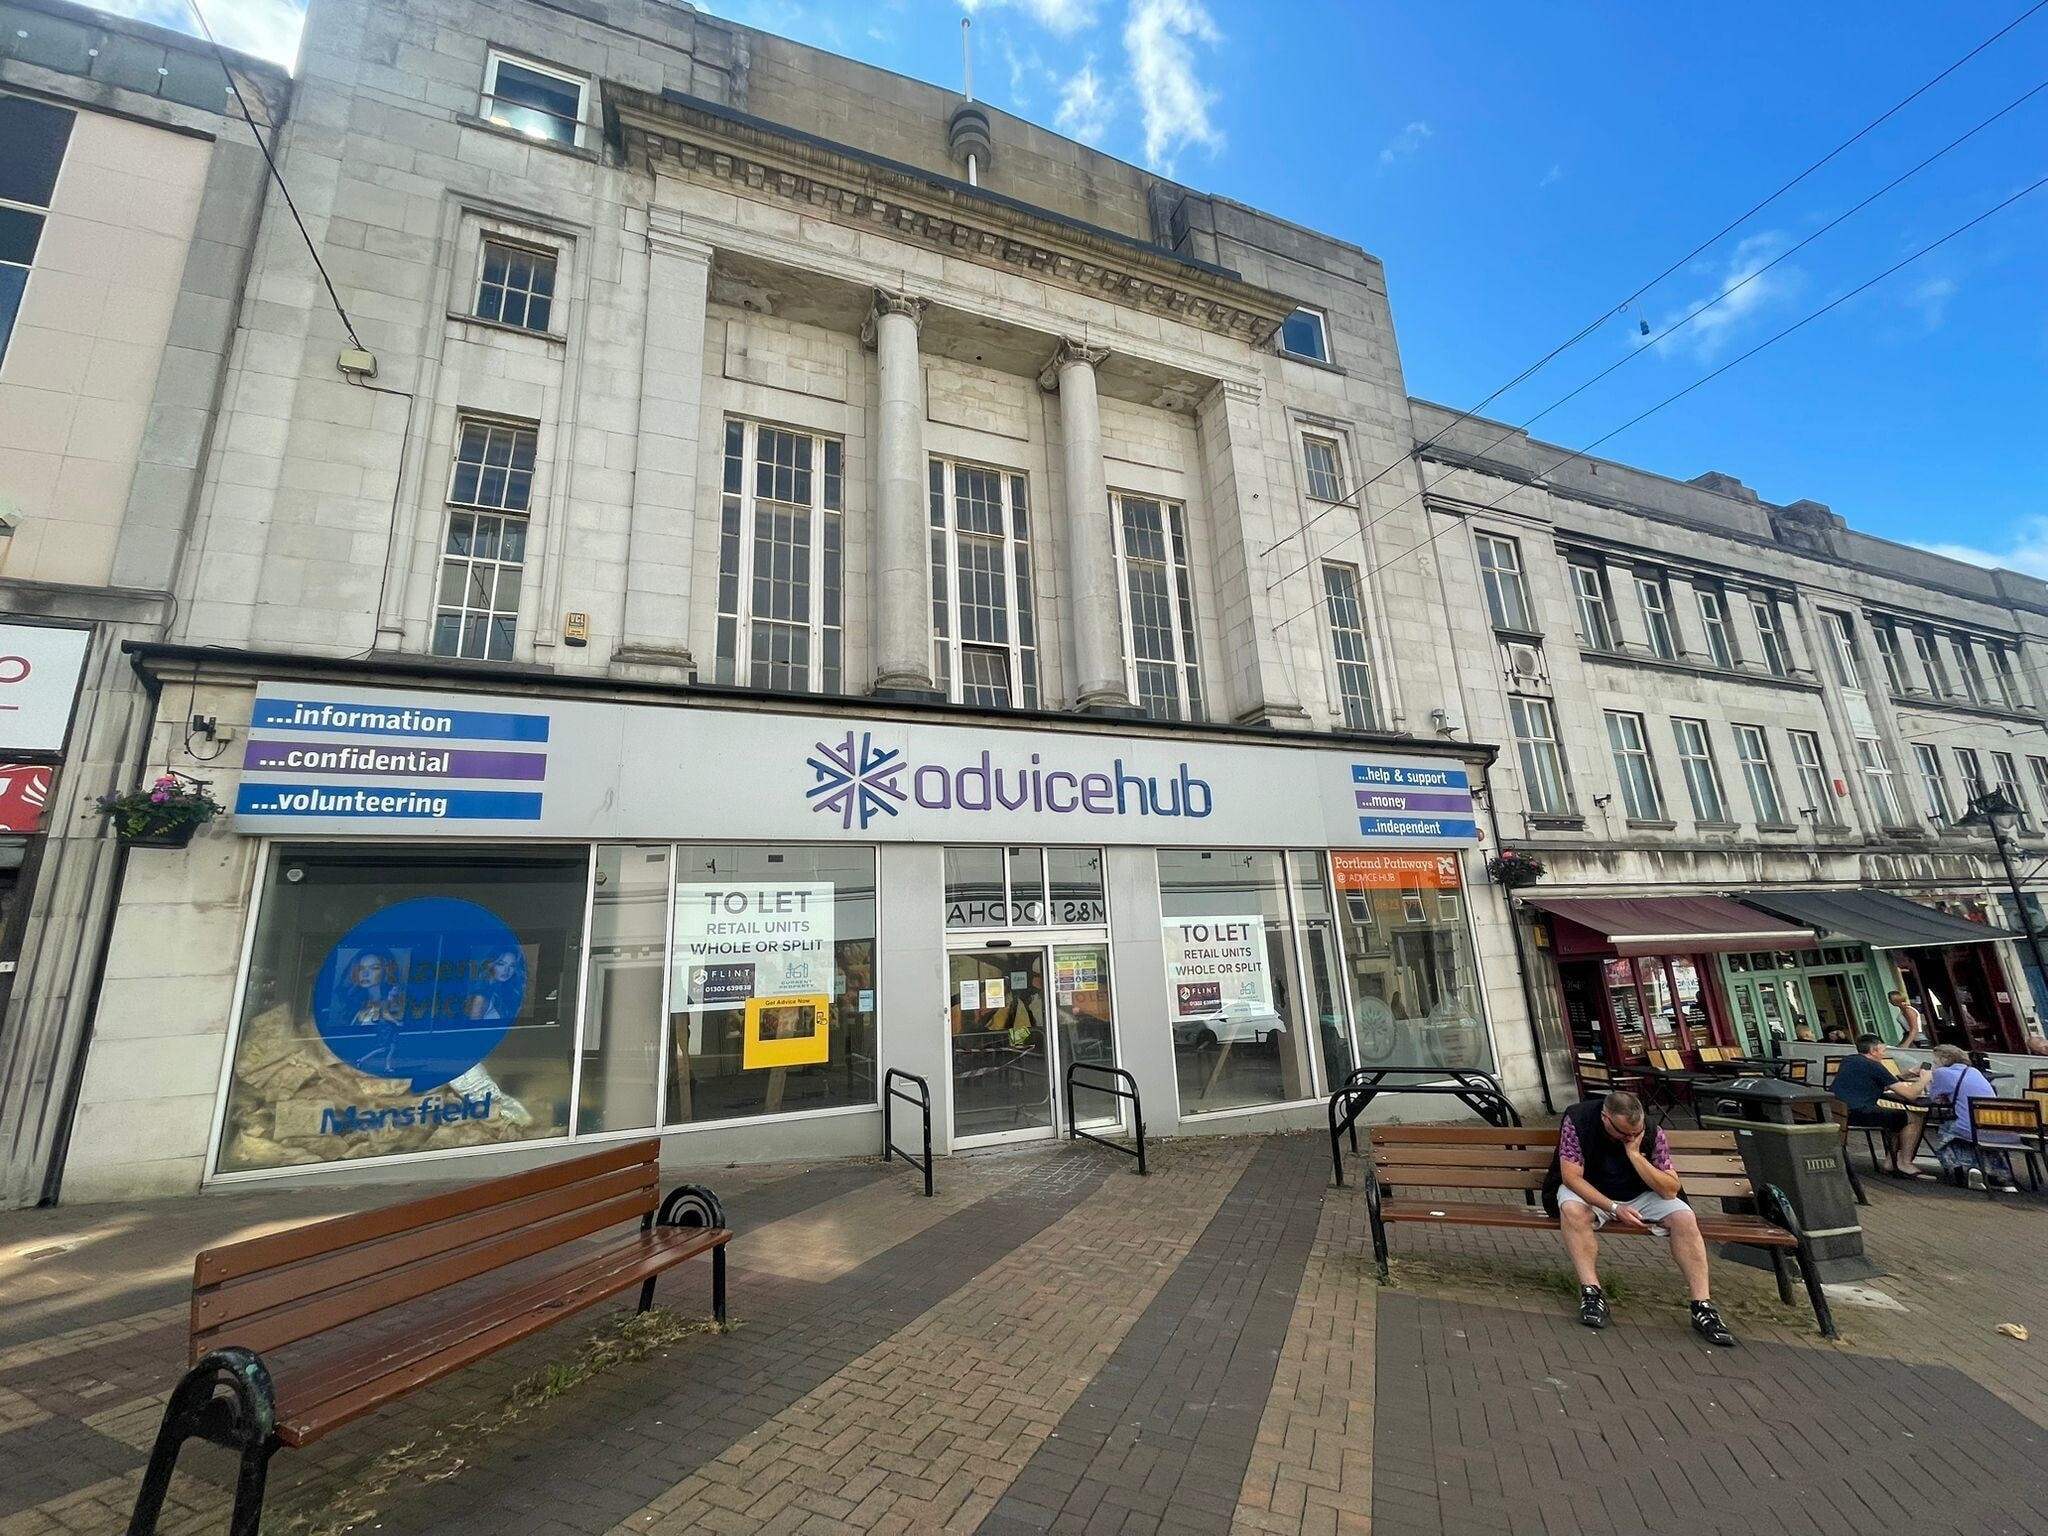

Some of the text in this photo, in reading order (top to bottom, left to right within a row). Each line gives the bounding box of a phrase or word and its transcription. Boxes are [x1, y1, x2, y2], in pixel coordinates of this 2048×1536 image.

[267, 703, 451, 732] ...information
[259, 748, 450, 773] ...confidential
[1358, 767, 1447, 786] ...help & support
[251, 788, 448, 817] ...volunteering
[1362, 795, 1406, 810] ...money
[1367, 819, 1441, 836] ...independent
[1334, 856, 1433, 872] Portland Pathways
[1336, 872, 1395, 883] @ ADVICE HUB
[704, 890, 812, 915] TO LET
[706, 920, 810, 935] RETAIL UNITS
[1179, 923, 1249, 942] TO LET
[690, 939, 823, 955] WHOLE OR SPLIT
[1184, 947, 1252, 959] RETAIL UNITS
[711, 969, 750, 978] FLINT
[1175, 962, 1262, 976] WHOLE OR SPLIT
[705, 985, 725, 993] 01302
[319, 1091, 492, 1135] Mansfield
[1806, 1158, 1836, 1171] LITTER
